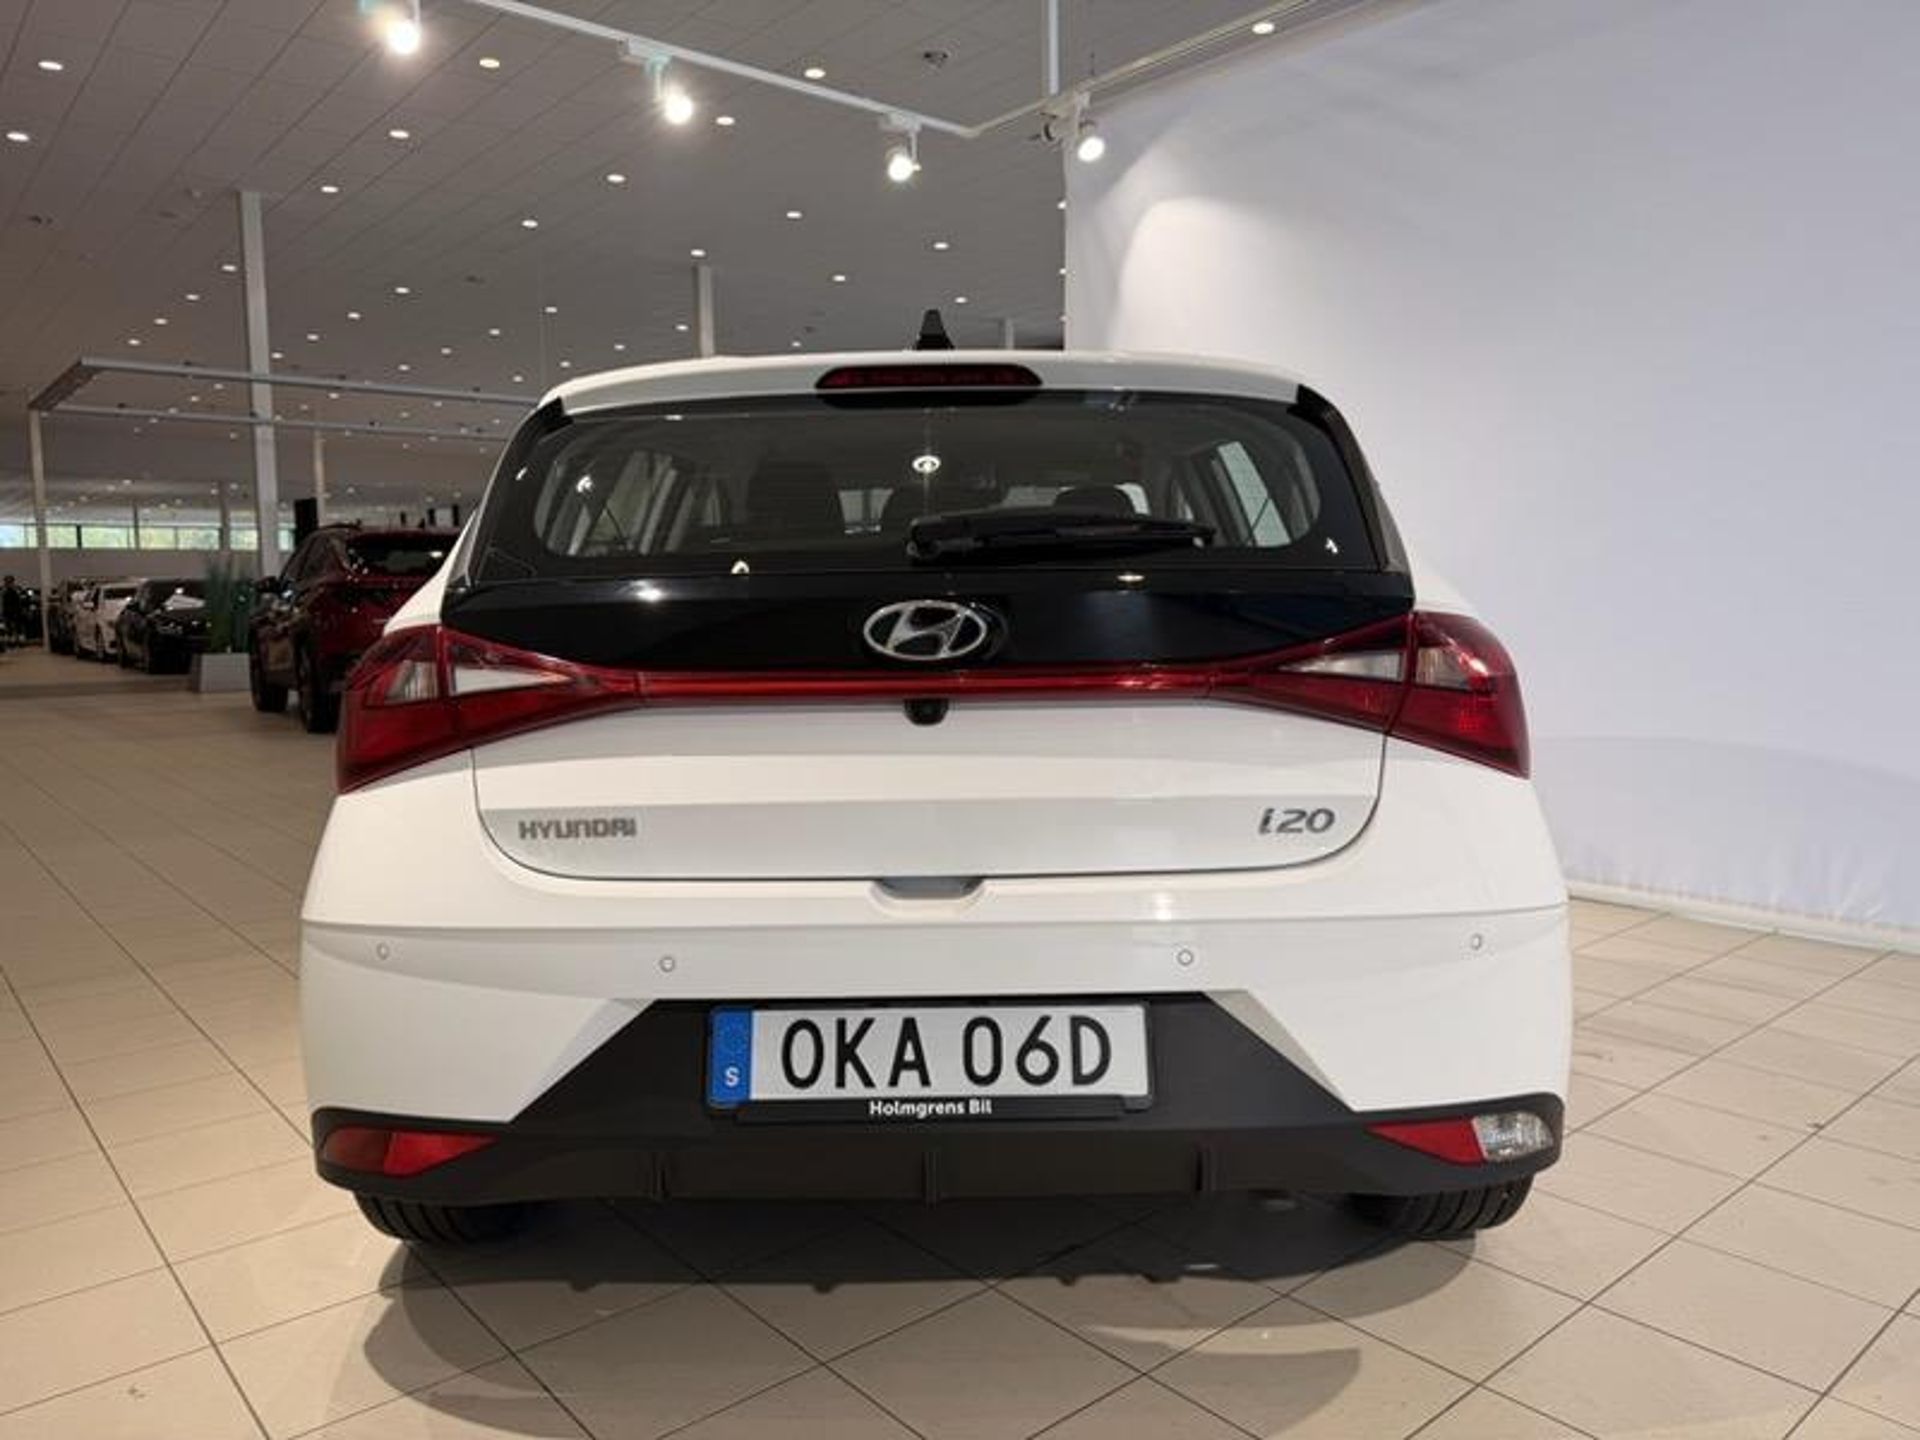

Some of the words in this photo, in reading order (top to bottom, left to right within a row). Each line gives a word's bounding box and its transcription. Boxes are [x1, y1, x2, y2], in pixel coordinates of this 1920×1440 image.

[518, 818, 638, 839] HYUNDAI
[1258, 808, 1335, 834] i20
[781, 1016, 932, 1089] OKA
[962, 1014, 1112, 1087] 06D
[724, 1067, 741, 1087] S
[869, 1100, 965, 1119] Holmgrens
[969, 1099, 993, 1115] Bil
